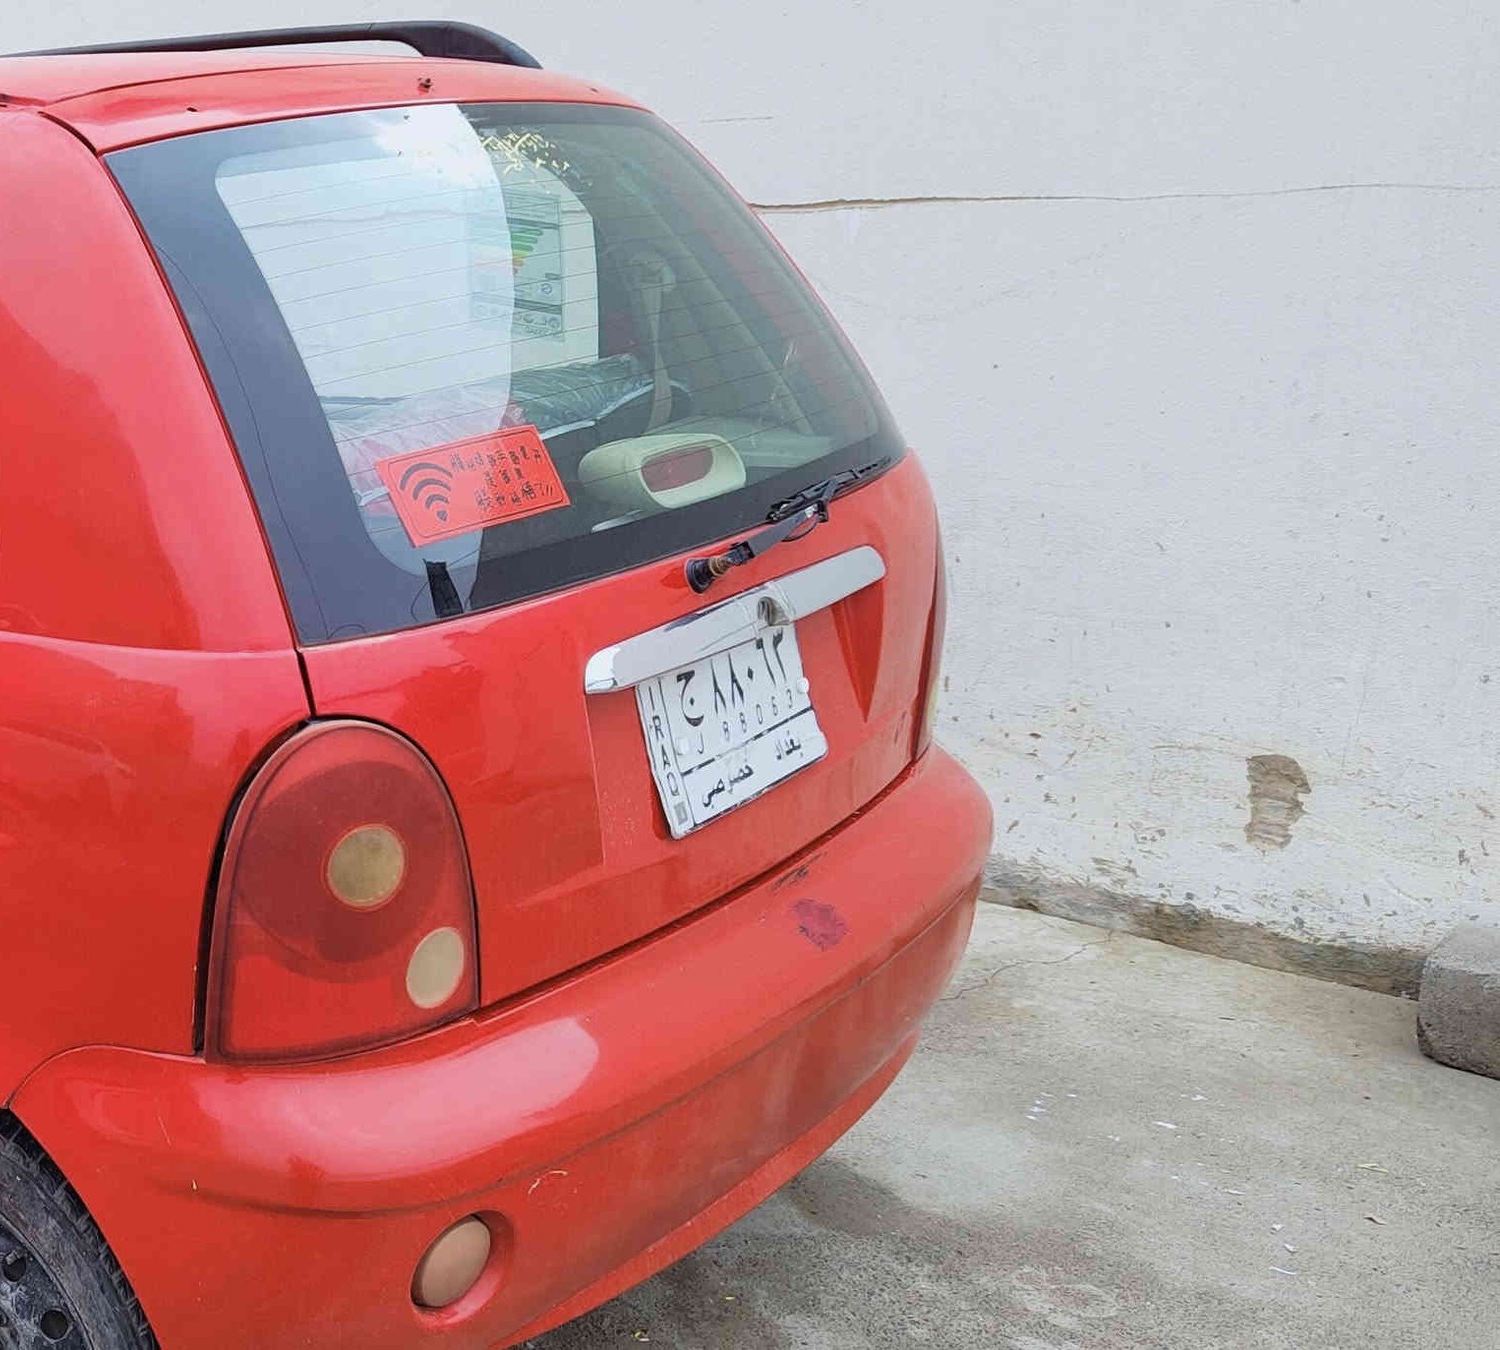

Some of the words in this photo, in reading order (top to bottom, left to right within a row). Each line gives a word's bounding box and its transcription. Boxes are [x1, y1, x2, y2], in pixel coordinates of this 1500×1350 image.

[676, 669, 705, 728] ج
[721, 687, 794, 743] 88063
[648, 685, 680, 797] IRAQ
